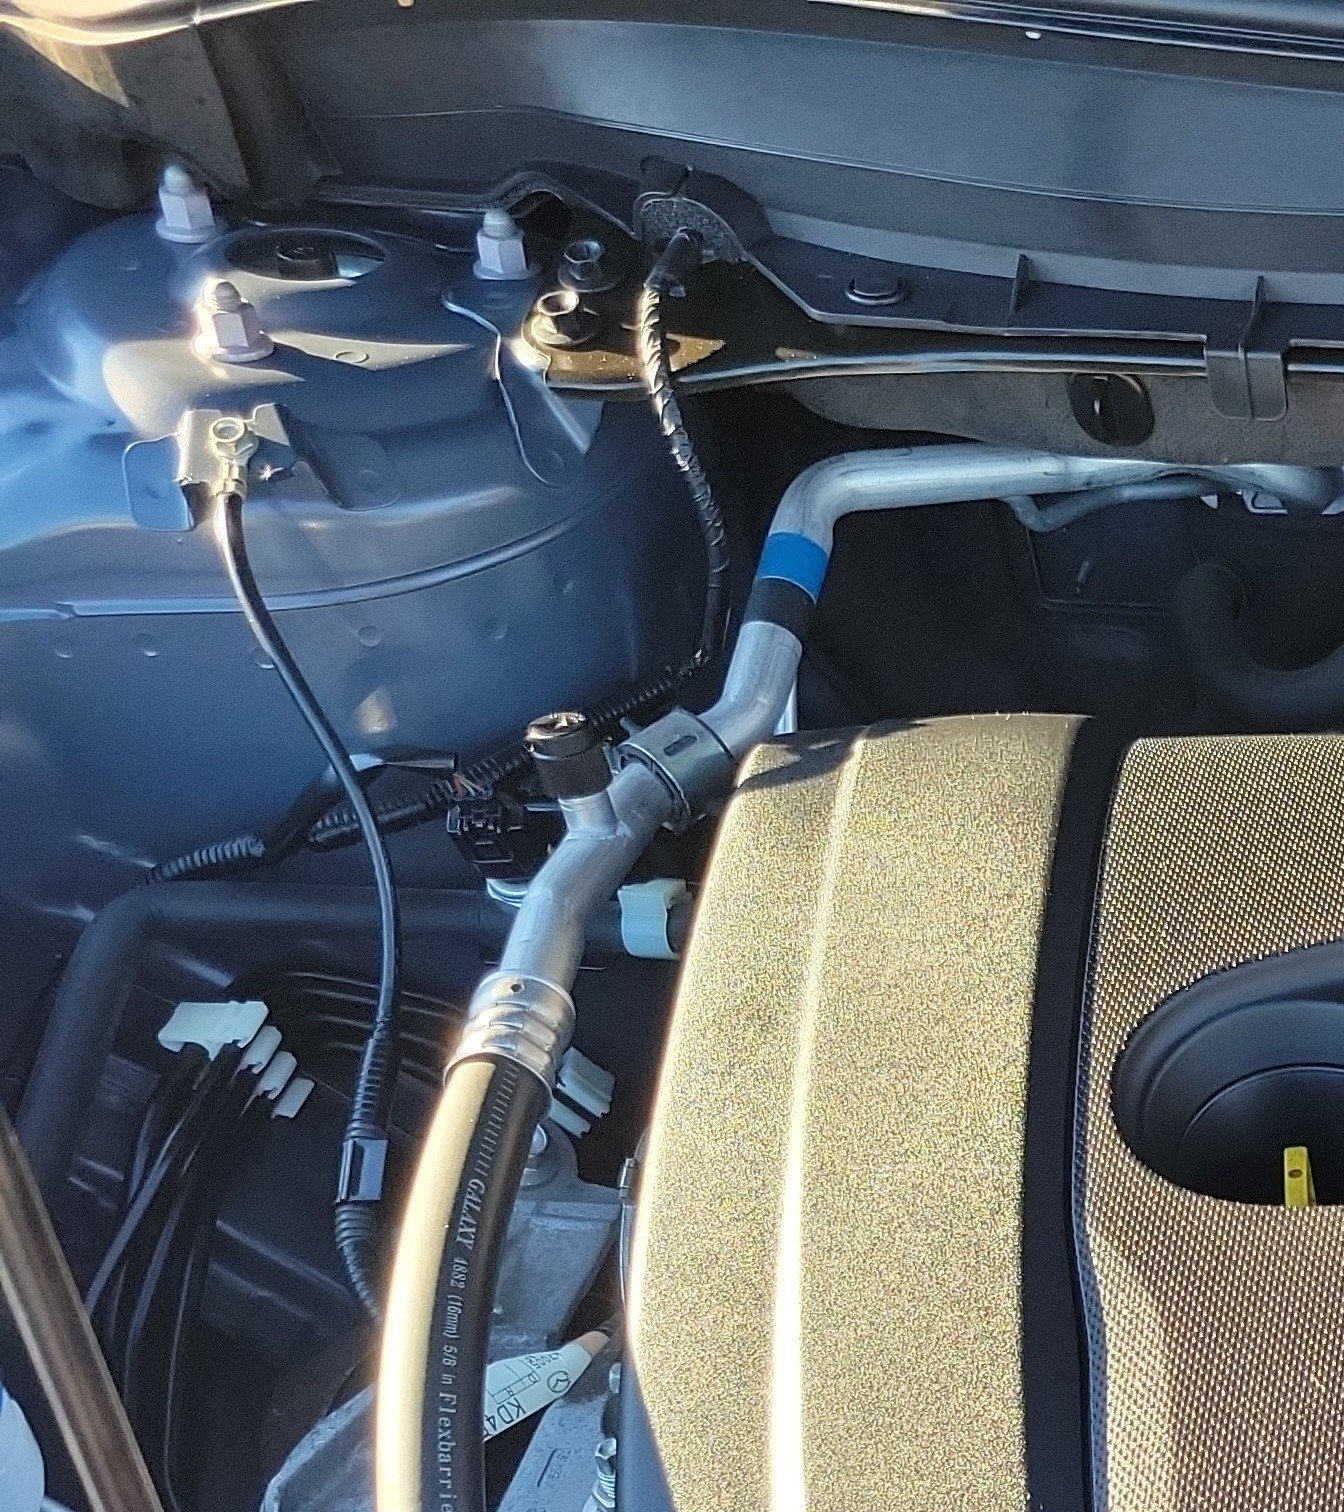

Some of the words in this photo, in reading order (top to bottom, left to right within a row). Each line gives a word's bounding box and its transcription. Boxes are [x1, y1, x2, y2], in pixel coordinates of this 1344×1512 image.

[455, 1178, 486, 1250] GALAXY
[450, 1257, 469, 1289] 4882
[443, 1294, 464, 1339] (16mm)
[443, 1345, 458, 1368] 5/8
[442, 1373, 457, 1385] in
